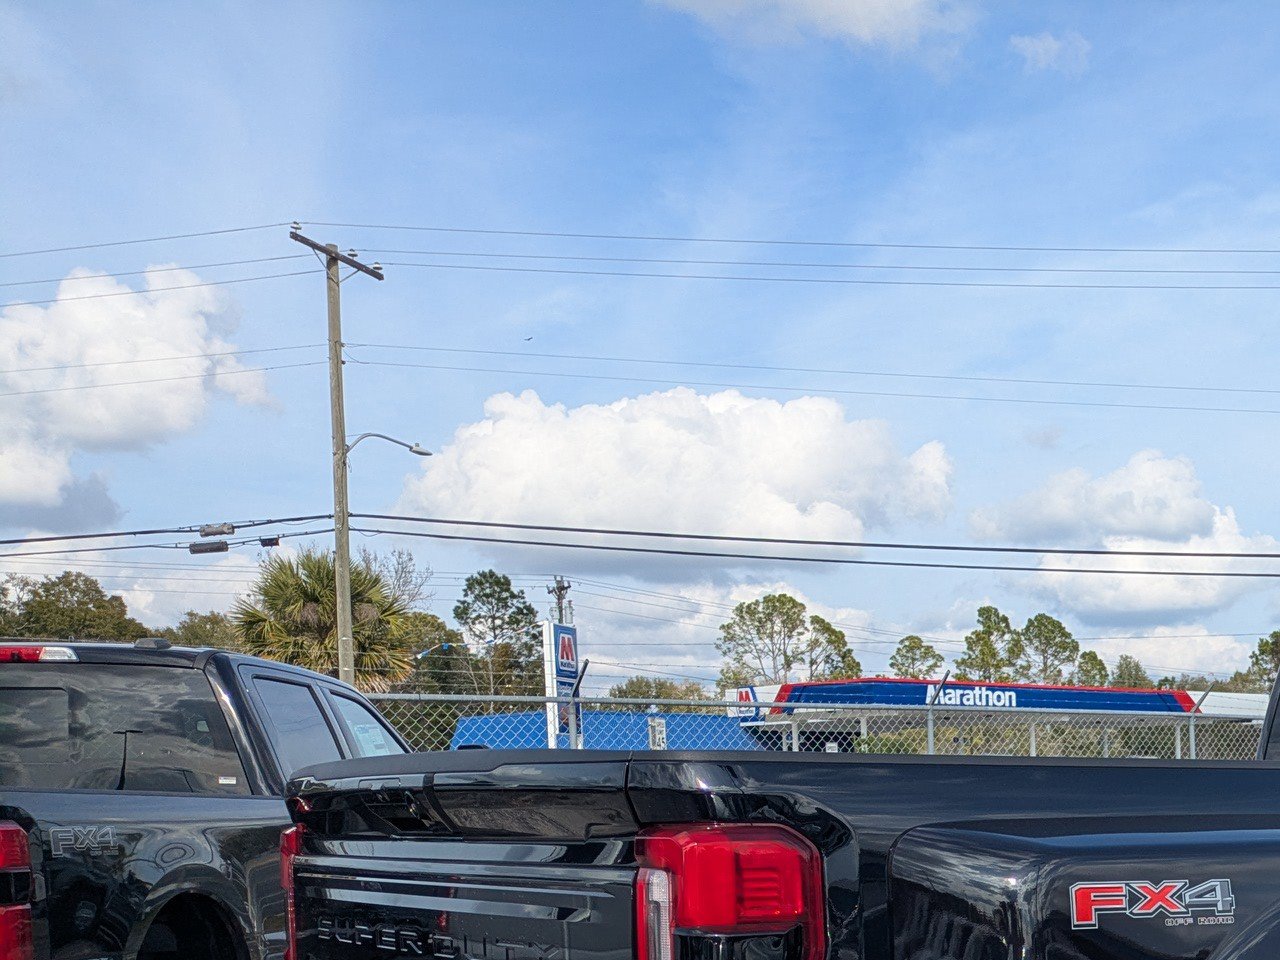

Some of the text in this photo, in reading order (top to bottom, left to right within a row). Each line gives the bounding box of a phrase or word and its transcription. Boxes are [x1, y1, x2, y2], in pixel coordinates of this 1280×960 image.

[925, 684, 1017, 707] Marathon
[49, 826, 119, 857] FX4
[1070, 879, 1235, 930] FX4
[318, 916, 423, 954] SUPER
[1164, 916, 1235, 927] OFF ROAD
